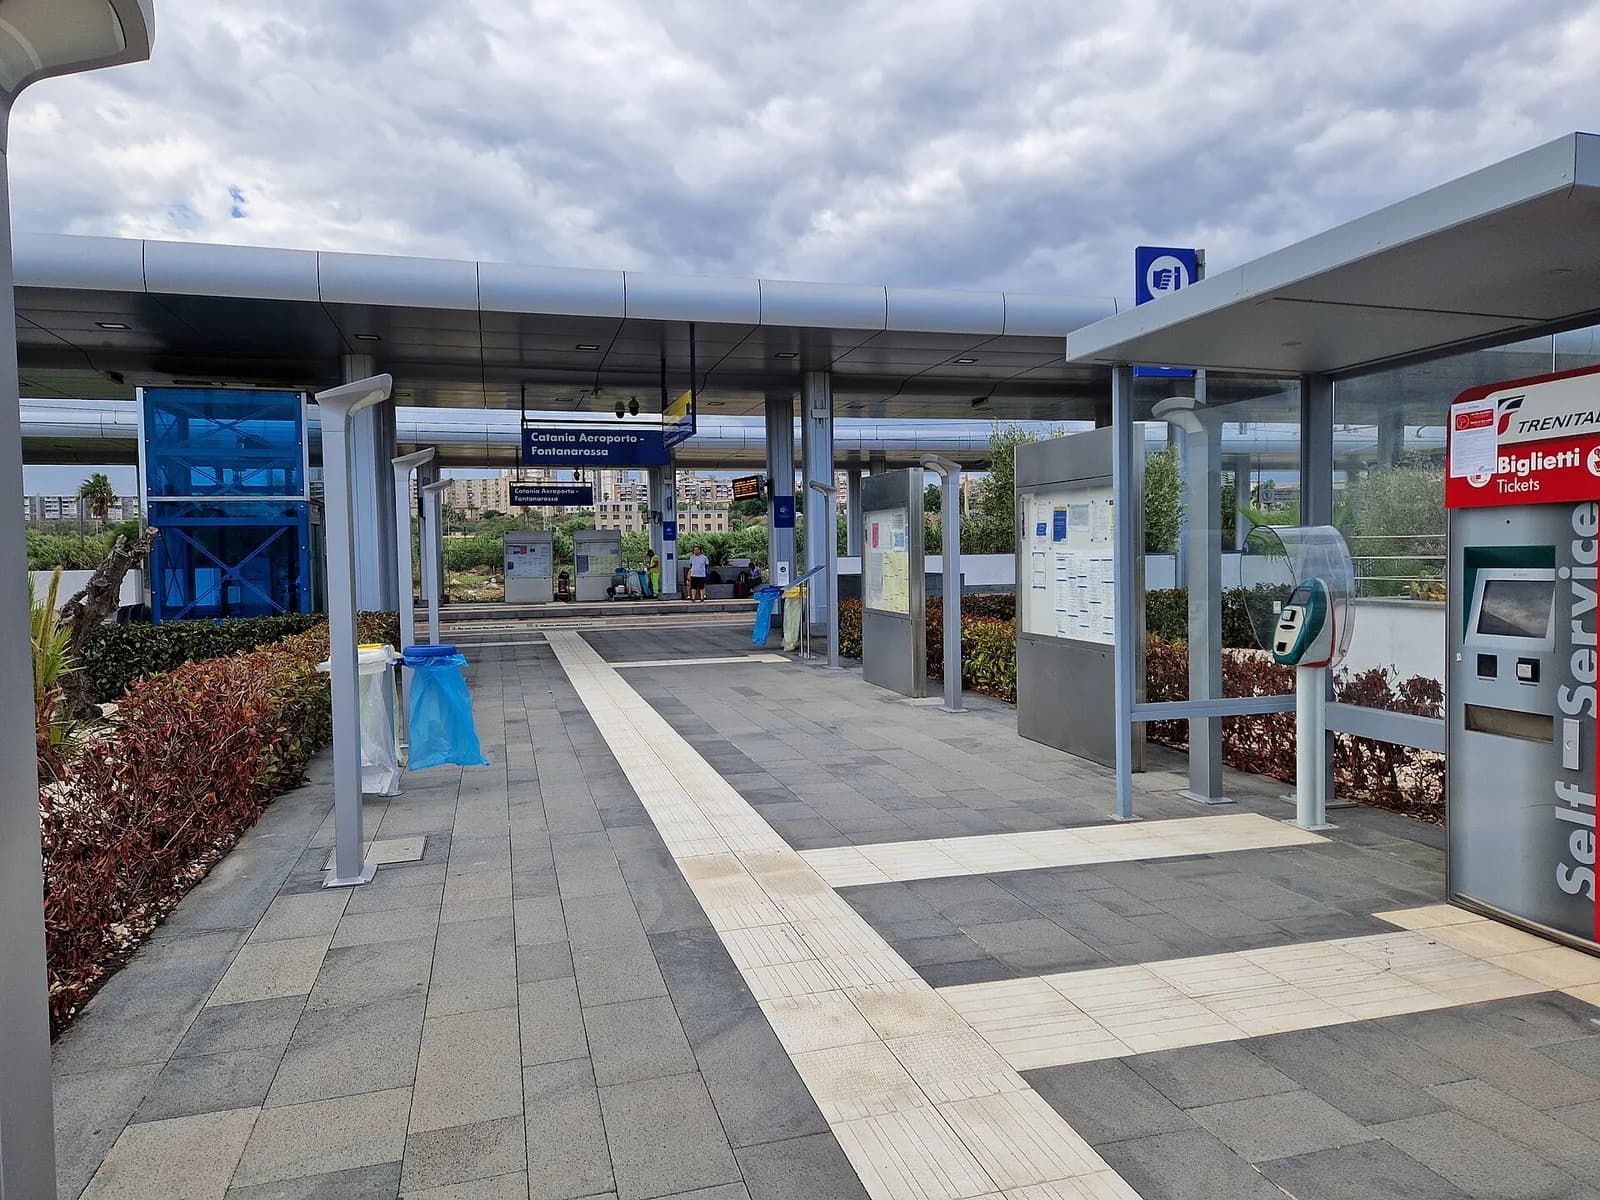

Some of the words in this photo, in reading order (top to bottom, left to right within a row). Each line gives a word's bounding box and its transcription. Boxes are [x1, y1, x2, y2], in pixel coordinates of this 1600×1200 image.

[531, 432, 576, 442] Catania
[579, 433, 638, 444] Aeroporto
[531, 446, 609, 456] Fontanarossa
[1498, 447, 1580, 477] Biglietti
[1496, 476, 1540, 494] Tickets
[1557, 502, 1599, 719] Service
[1555, 779, 1597, 902] Self
